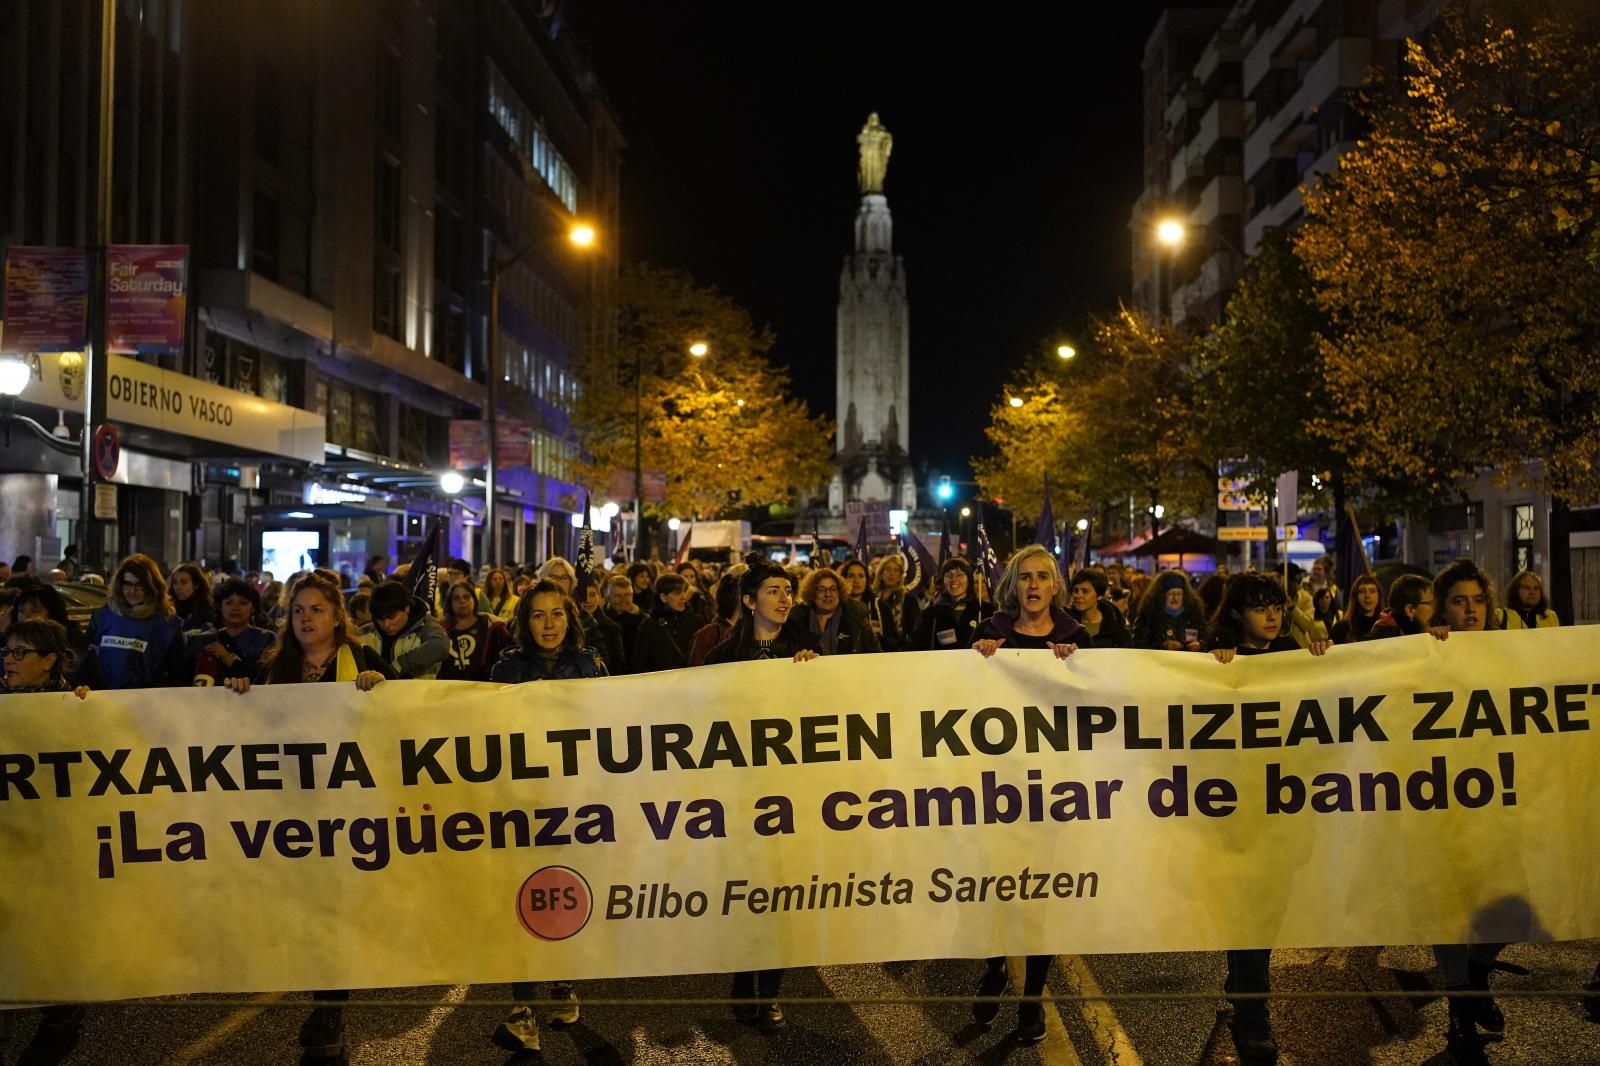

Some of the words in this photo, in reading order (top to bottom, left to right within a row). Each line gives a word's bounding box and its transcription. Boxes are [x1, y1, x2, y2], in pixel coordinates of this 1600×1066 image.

[110, 277, 184, 297] Saturday
[111, 261, 139, 277] Fair
[109, 374, 182, 414] OBIERNO
[189, 394, 233, 427] VASCO
[399, 712, 893, 786] KULTURAREN
[920, 692, 1389, 758] KONPLIZEAK
[1412, 683, 1600, 741] ZARE
[96, 809, 207, 879] ¡La
[229, 802, 617, 872] vergüenza
[639, 798, 727, 841] va
[753, 795, 796, 837] a
[821, 769, 1124, 832] cambiar
[1147, 765, 1238, 818] de
[1265, 751, 1517, 815] bando!
[529, 886, 578, 912] BFS
[605, 883, 708, 920] Bilbo
[721, 872, 914, 916] Feminista
[928, 866, 1099, 905] Saretzen
